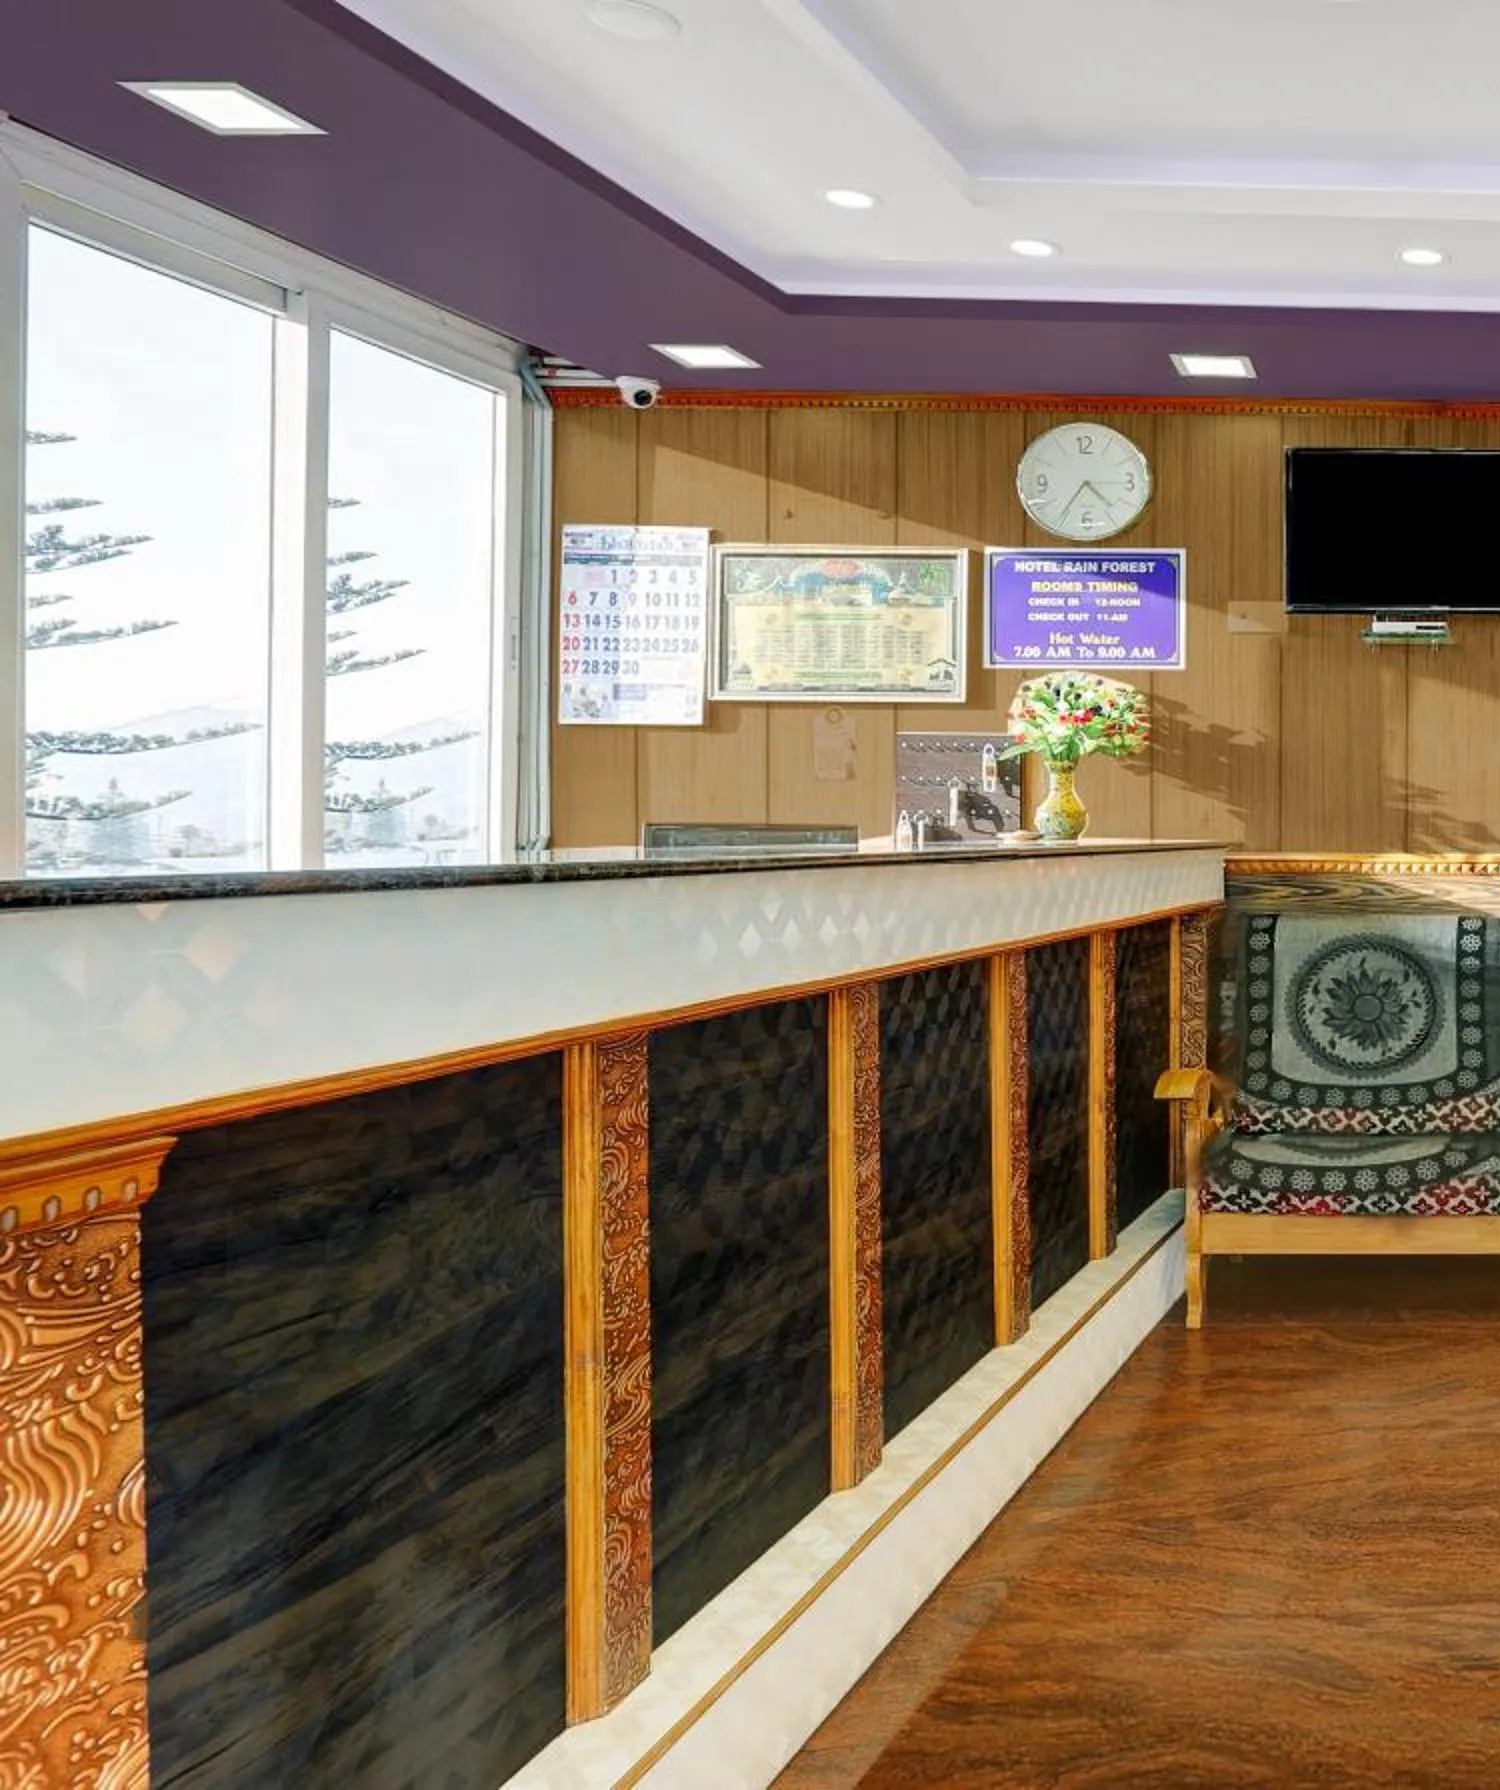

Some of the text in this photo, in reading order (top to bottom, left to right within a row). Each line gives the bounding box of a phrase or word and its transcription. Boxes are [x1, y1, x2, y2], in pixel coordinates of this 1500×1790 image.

[1076, 435, 1094, 455] 12
[1036, 474, 1048, 493] 9
[1125, 472, 1135, 492] 3
[1081, 511, 1093, 530] 6
[1014, 561, 1156, 573] HOTEL RAIN FOREST
[611, 569, 617, 584] 1
[648, 569, 657, 584] 3
[668, 569, 678, 584] 4
[688, 570, 697, 585] 5
[1031, 581, 1138, 593] ROOMS TIMING
[568, 591, 700, 607] 6 7 8 9 10 11 12
[1028, 597, 1065, 607] CHECK
[1067, 597, 1079, 607] IN
[564, 613, 700, 631] 13 14 15 16 17 18 19
[1027, 613, 1064, 621] CHECK
[1067, 613, 1090, 621] OUT
[562, 636, 699, 653] 20 21 22 23 24 25 26
[1049, 632, 1121, 645] Hot Water
[1013, 646, 1041, 658] 7.00
[1045, 646, 1071, 658] AM
[1076, 646, 1095, 658] To
[1129, 646, 1156, 658] AM
[562, 660, 639, 675] 27 28 29 30
